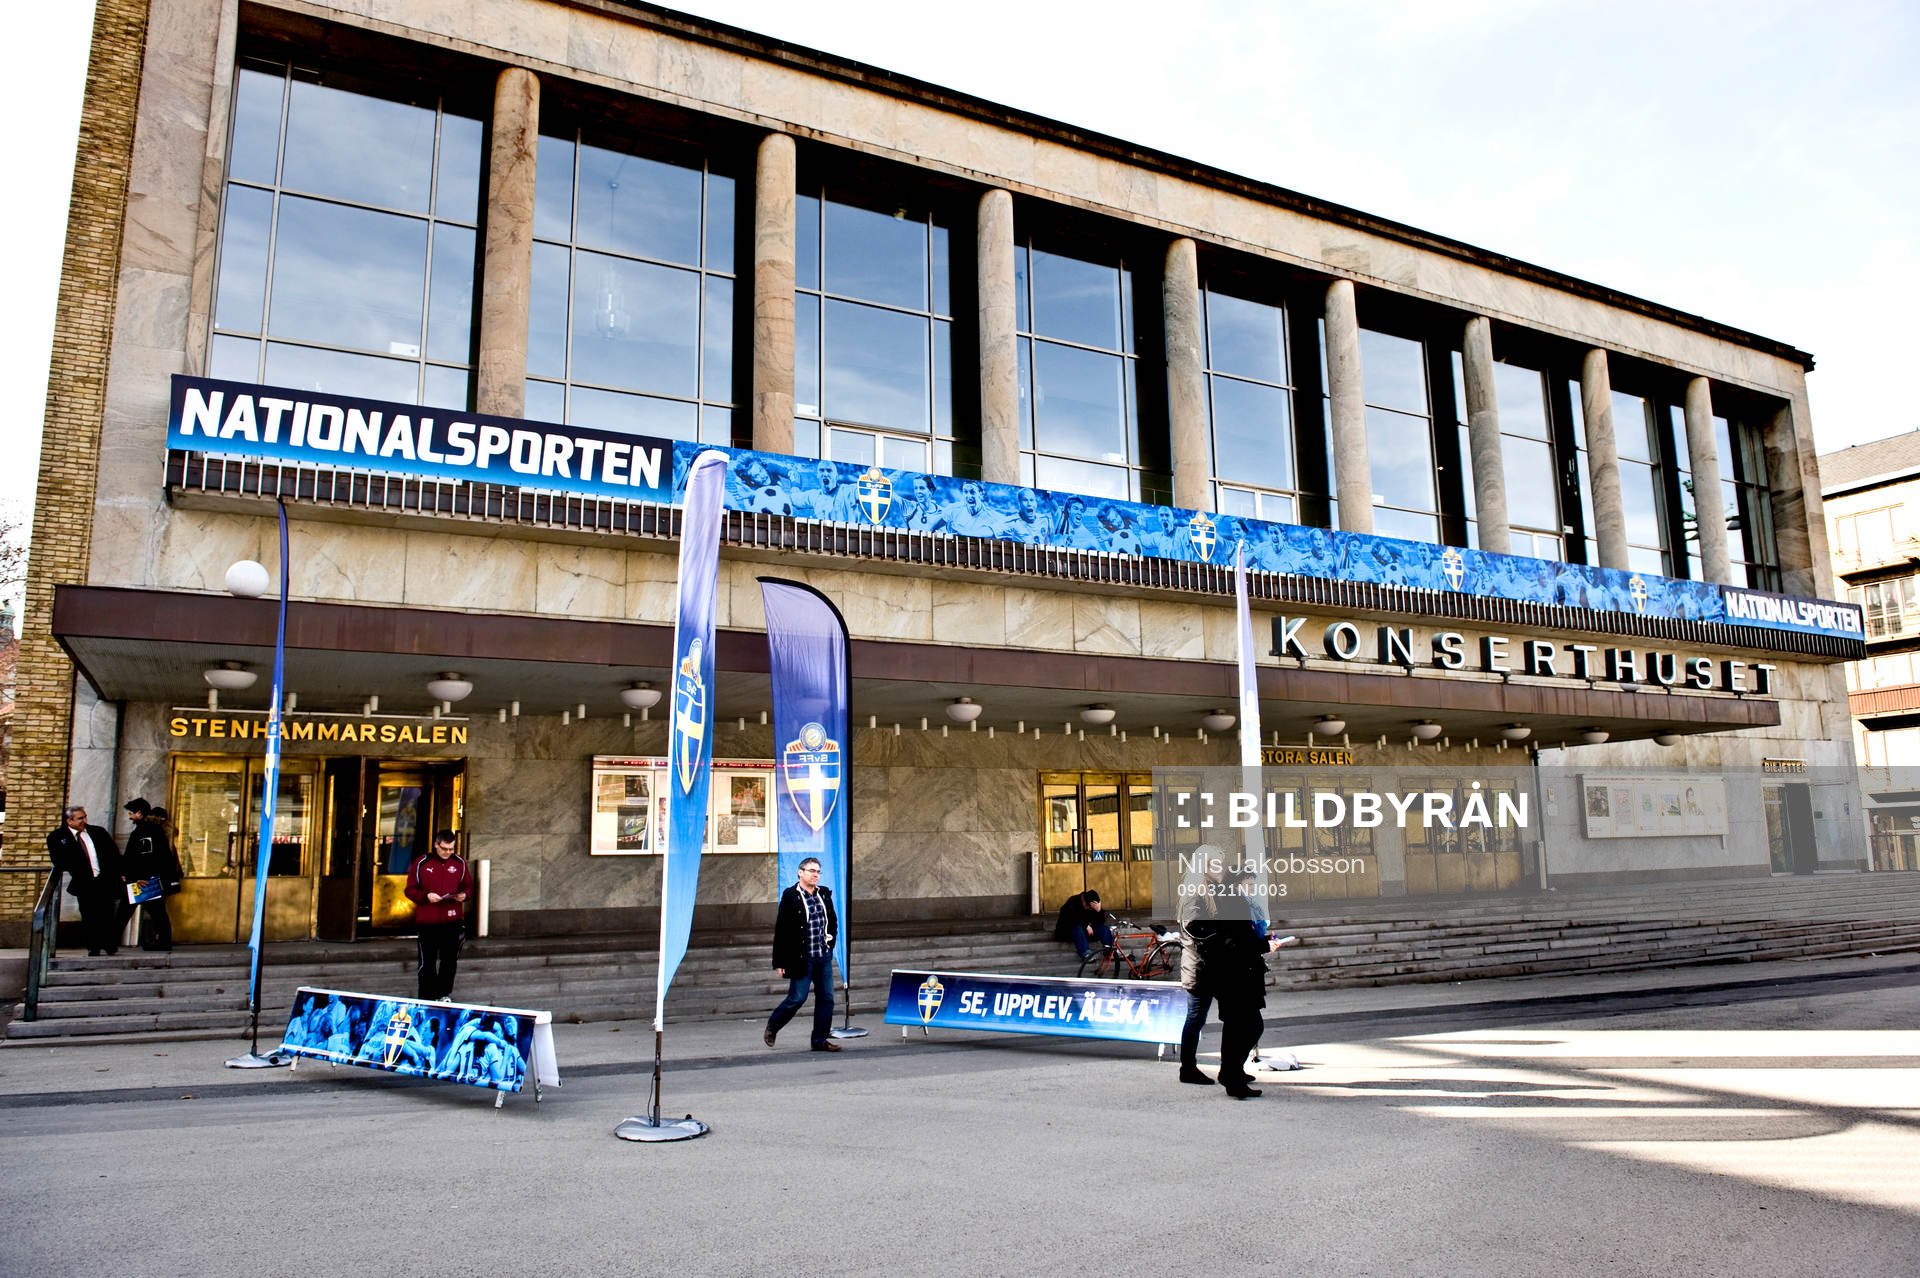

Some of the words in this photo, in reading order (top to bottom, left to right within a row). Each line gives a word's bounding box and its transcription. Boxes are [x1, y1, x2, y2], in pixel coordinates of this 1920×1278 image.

[179, 387, 663, 490] NATIONALSPORTEN
[1725, 591, 1862, 633] NATIONALSPORTEN
[1271, 615, 1777, 696] KONSERTHUSET
[169, 717, 468, 744] STENHAMMARSALEN
[1310, 751, 1353, 765] SALEN
[1764, 762, 1807, 773] BILJETTER
[959, 991, 988, 1018] SE,
[993, 993, 1073, 1023] UPPLEV,
[1079, 991, 1151, 1025] ÄLSKA
